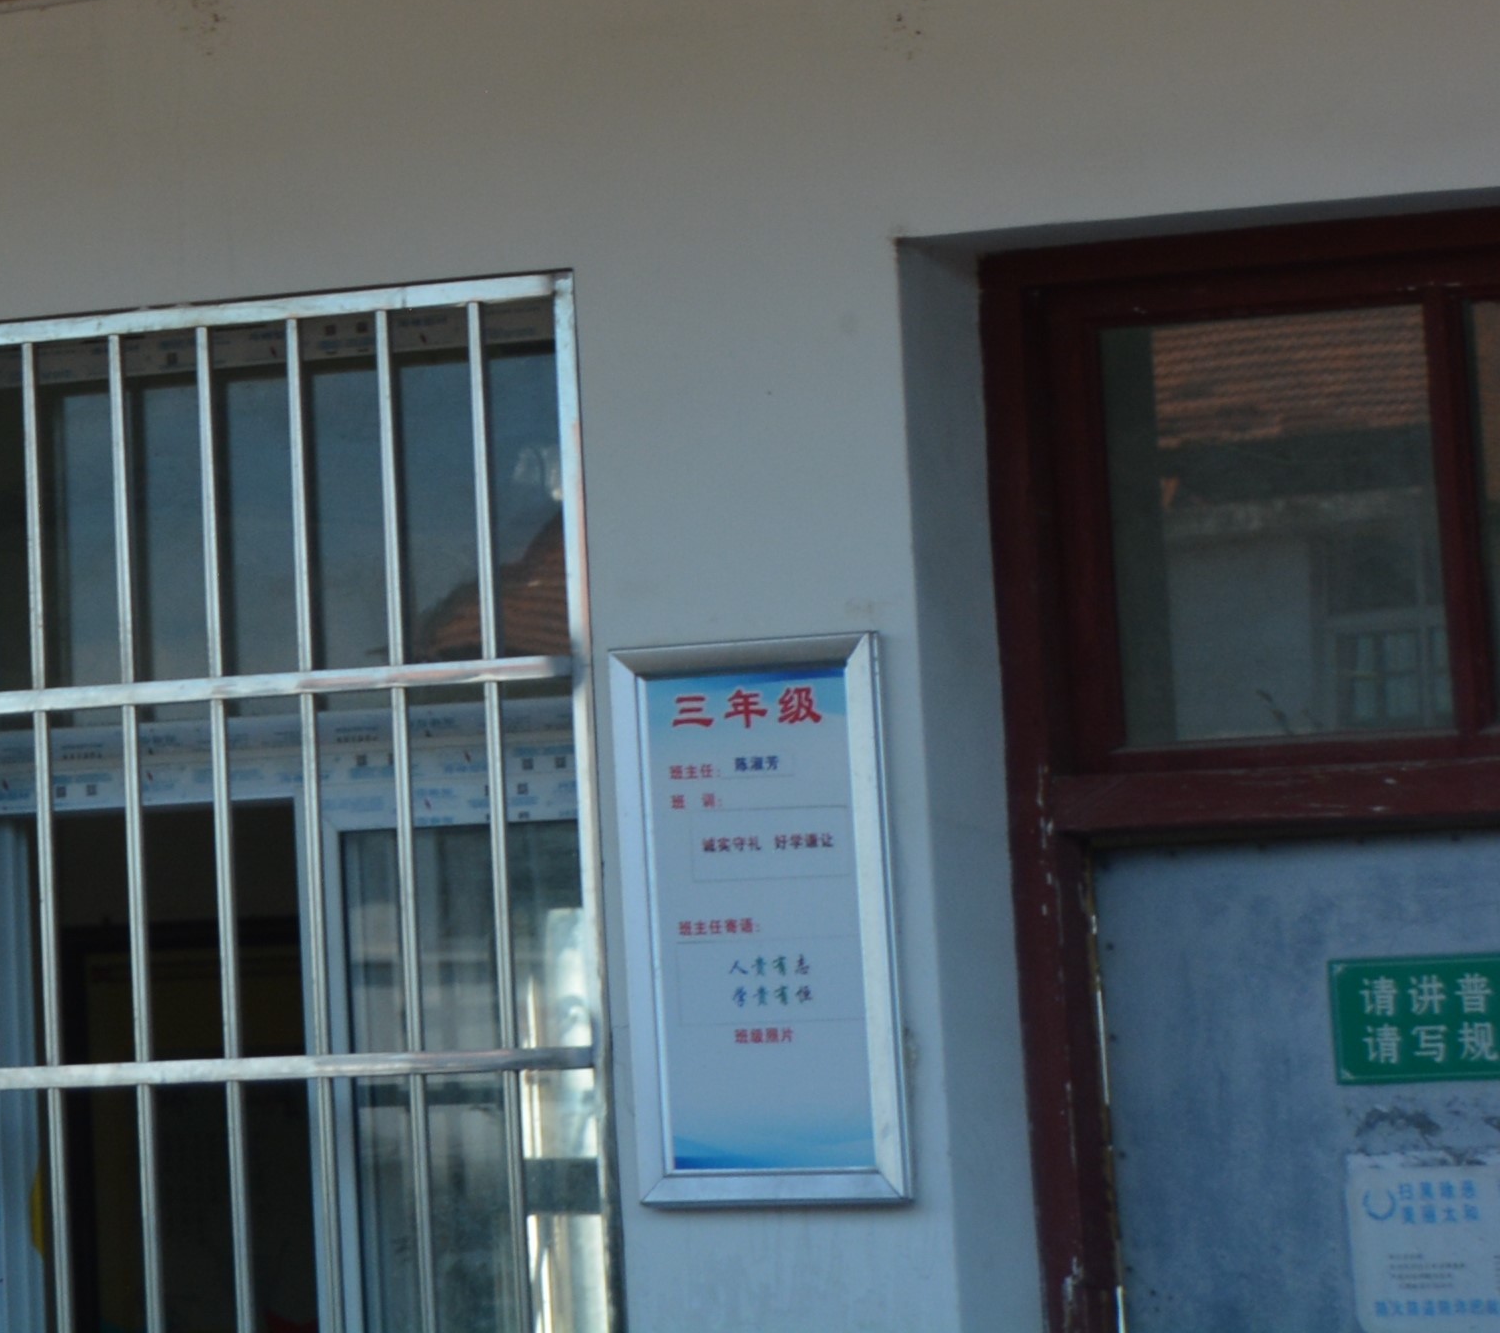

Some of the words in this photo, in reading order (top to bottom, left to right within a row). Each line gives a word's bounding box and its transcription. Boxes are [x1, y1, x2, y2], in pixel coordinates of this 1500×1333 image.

[671, 685, 823, 729] 三年级
[670, 794, 686, 810] 班
[702, 835, 762, 853] 诚实守礼
[1359, 972, 1493, 1016] 请讲普
[734, 1027, 794, 1044] 班级照片
[1362, 1021, 1500, 1064] 请写规
